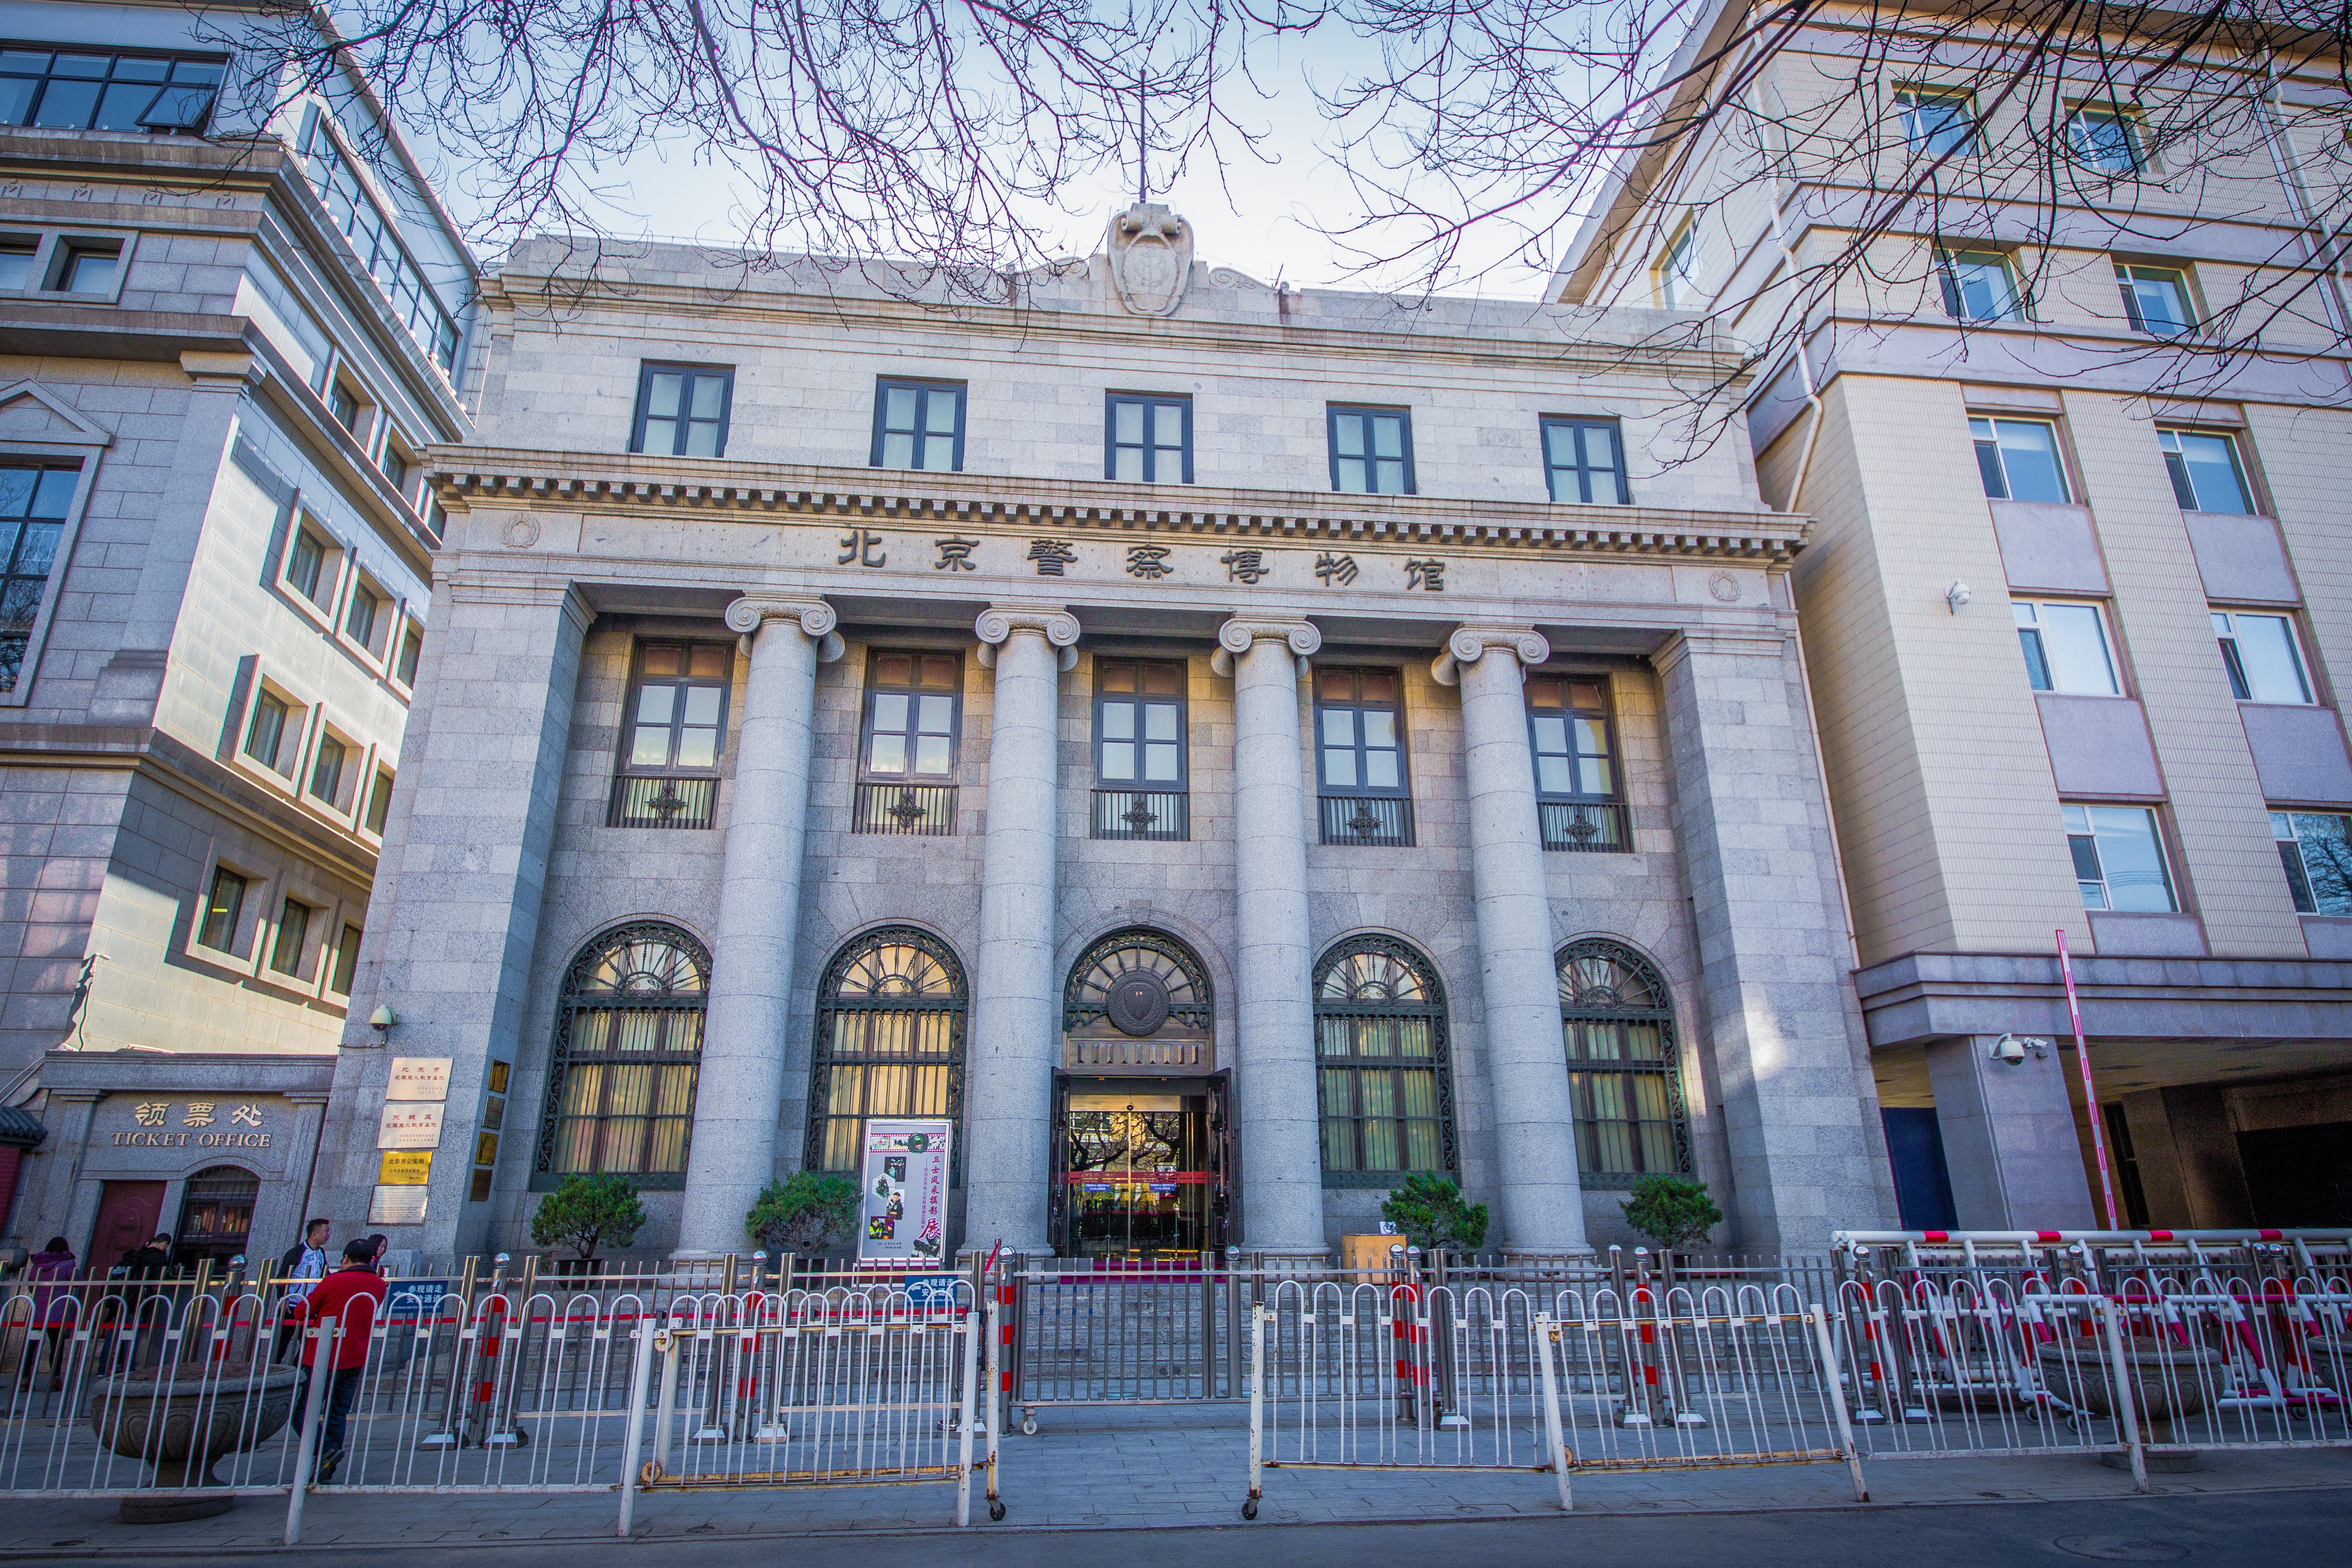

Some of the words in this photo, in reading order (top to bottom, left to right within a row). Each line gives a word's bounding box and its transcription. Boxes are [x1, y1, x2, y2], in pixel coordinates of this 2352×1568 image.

[838, 529, 1445, 591] 北京警察博物馆
[134, 1102, 263, 1128] 领票处
[112, 1132, 190, 1147] TICKET
[198, 1133, 272, 1148] OFFICE
[918, 1156, 941, 1239] 卫士风采摄影展
[408, 1284, 443, 1294] 参观请走
